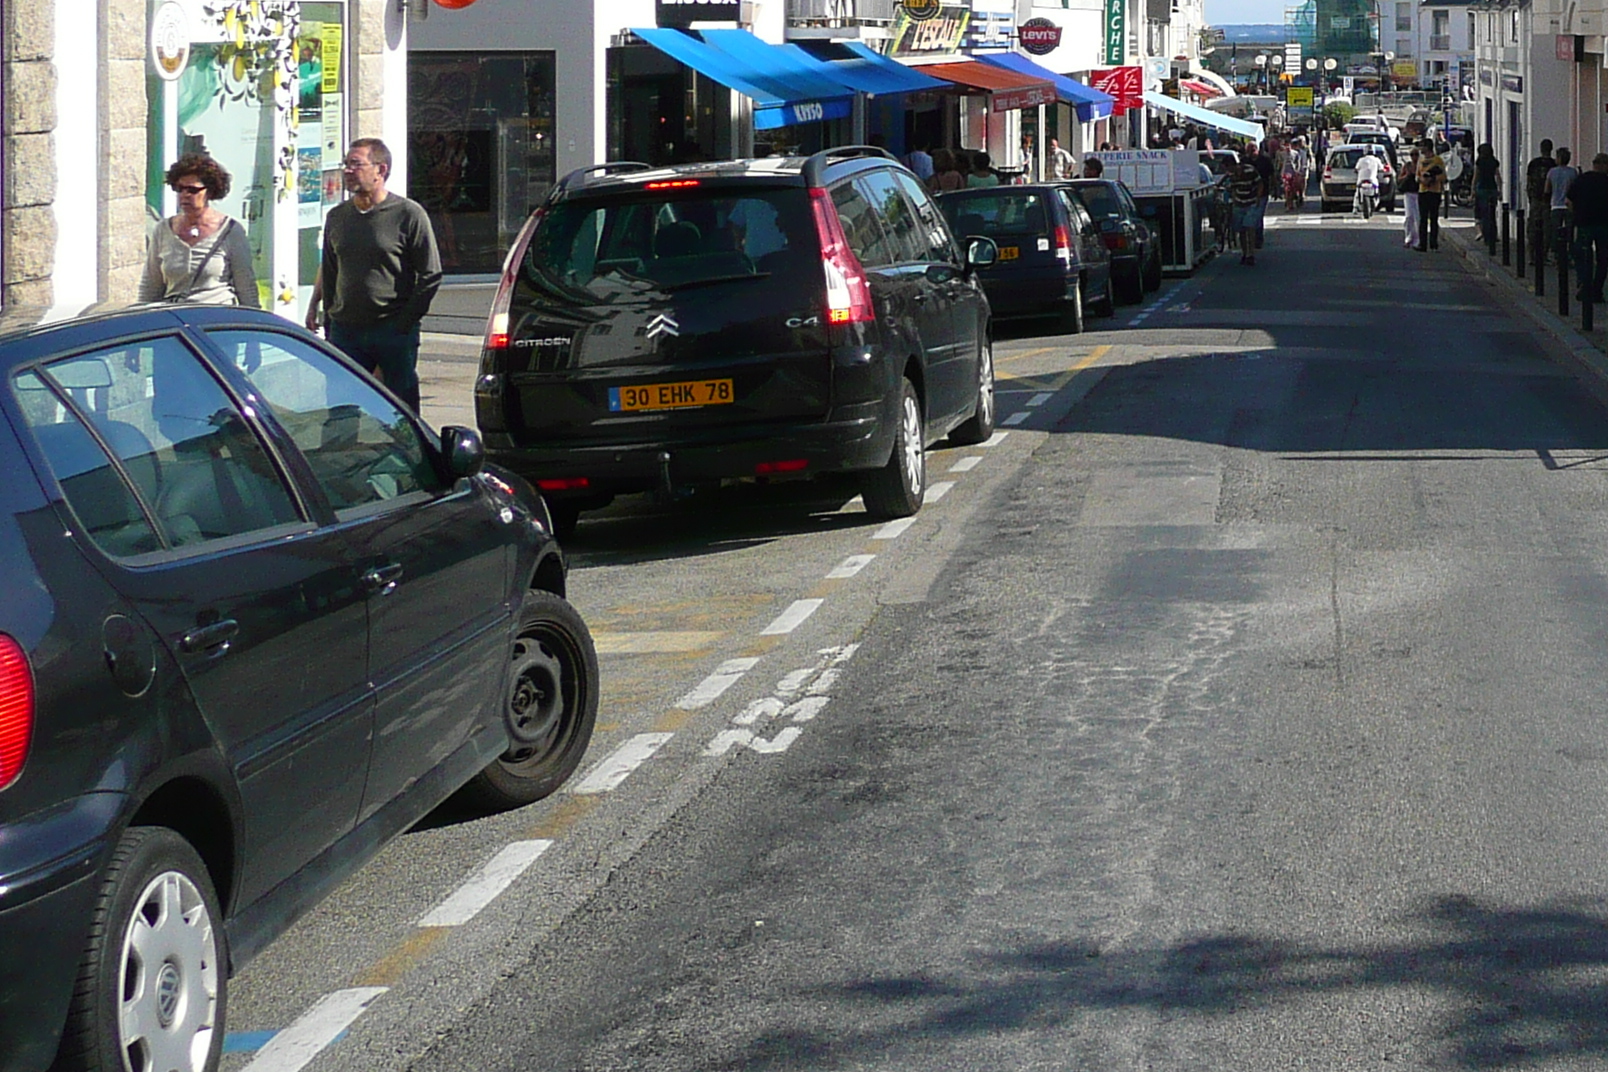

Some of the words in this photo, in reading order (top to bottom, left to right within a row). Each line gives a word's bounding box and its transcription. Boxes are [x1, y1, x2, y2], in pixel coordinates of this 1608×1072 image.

[785, 316, 818, 328] C4
[625, 388, 650, 407] 30
[658, 383, 696, 404] EHK
[704, 382, 730, 401] 78
